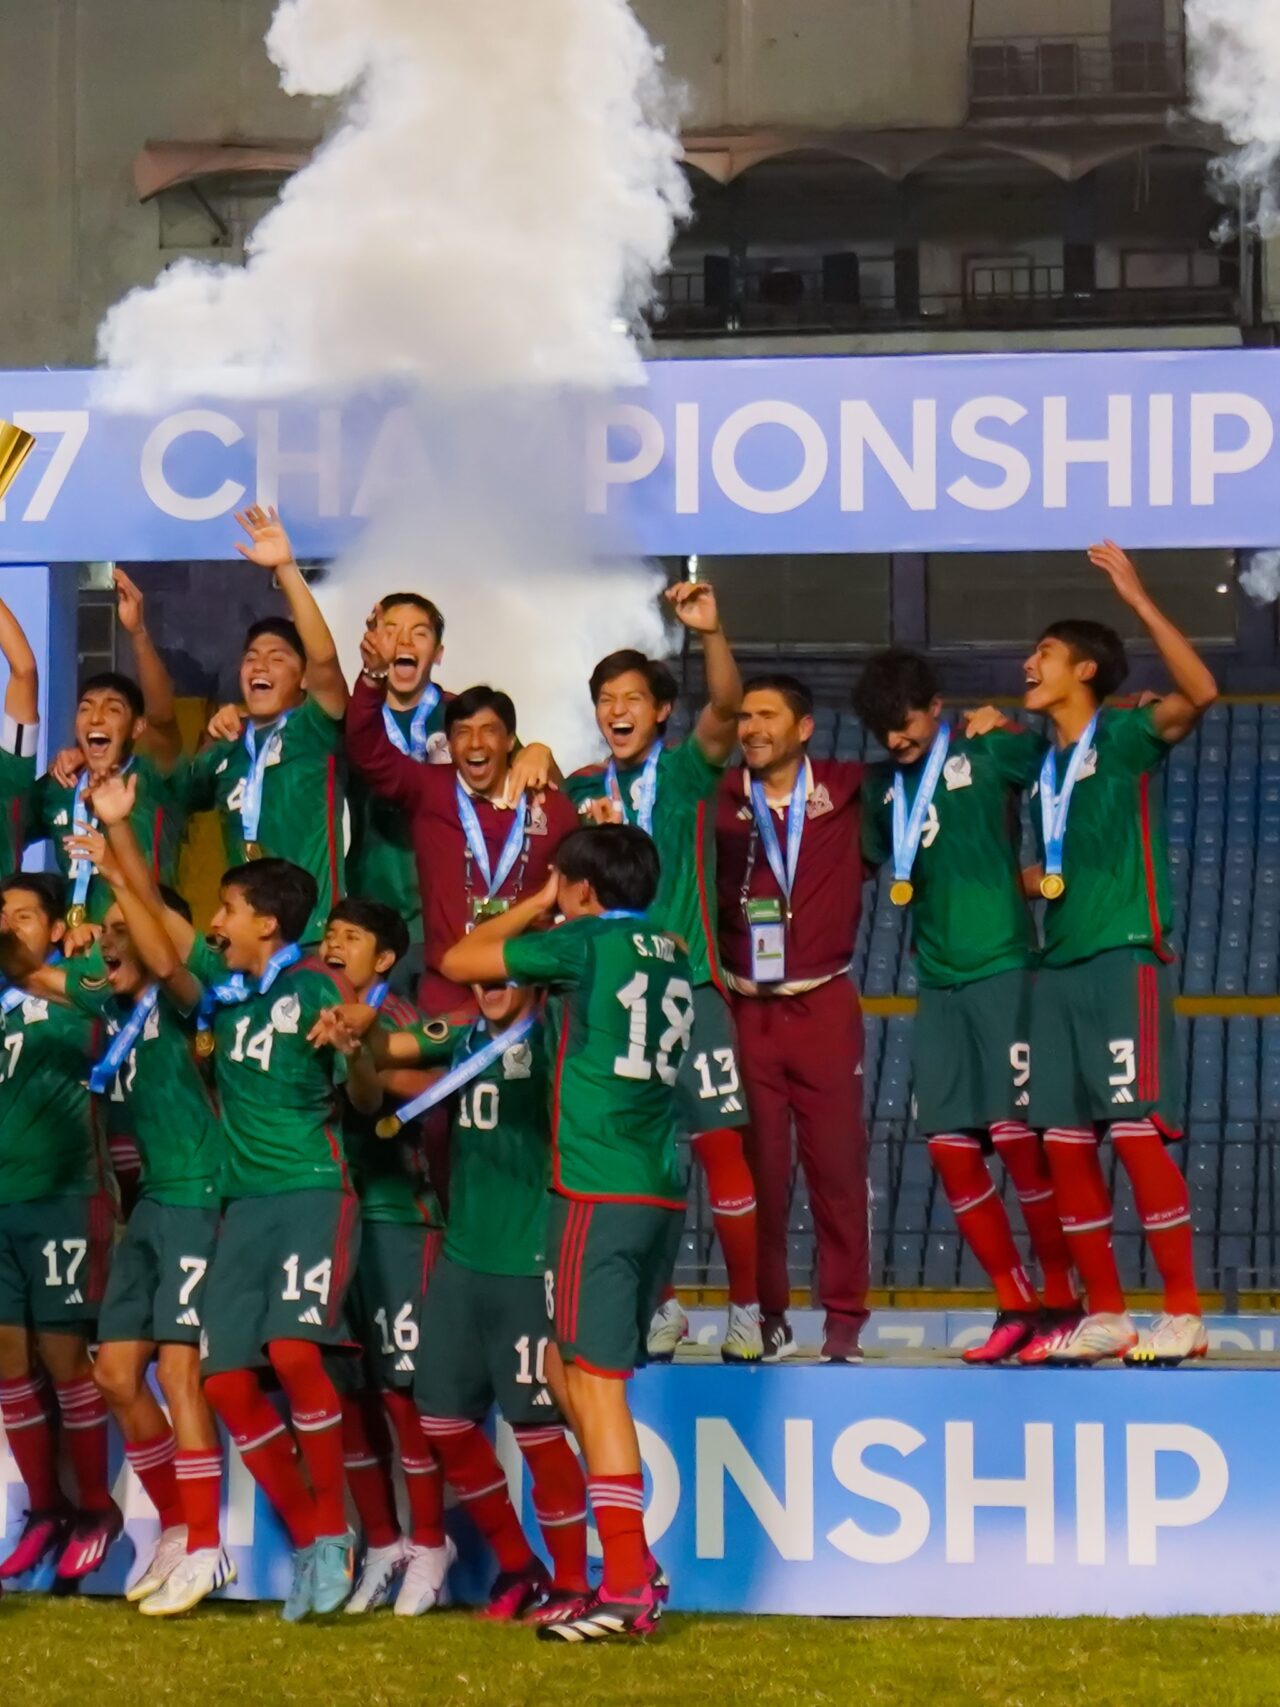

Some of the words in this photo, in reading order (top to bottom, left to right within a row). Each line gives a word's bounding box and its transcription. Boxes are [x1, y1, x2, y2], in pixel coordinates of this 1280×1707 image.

[139, 391, 1276, 522] CHAPIONSHIP
[229, 1015, 274, 1072] 14
[614, 971, 694, 1087] 18
[693, 1047, 738, 1099] 13
[1009, 1042, 1030, 1087] 9
[1108, 1038, 1135, 1086] 3
[458, 1082, 500, 1130] 10
[41, 1238, 87, 1287] 17
[179, 1255, 208, 1305] 7
[281, 1253, 332, 1306] 14
[374, 1302, 419, 1355] 16
